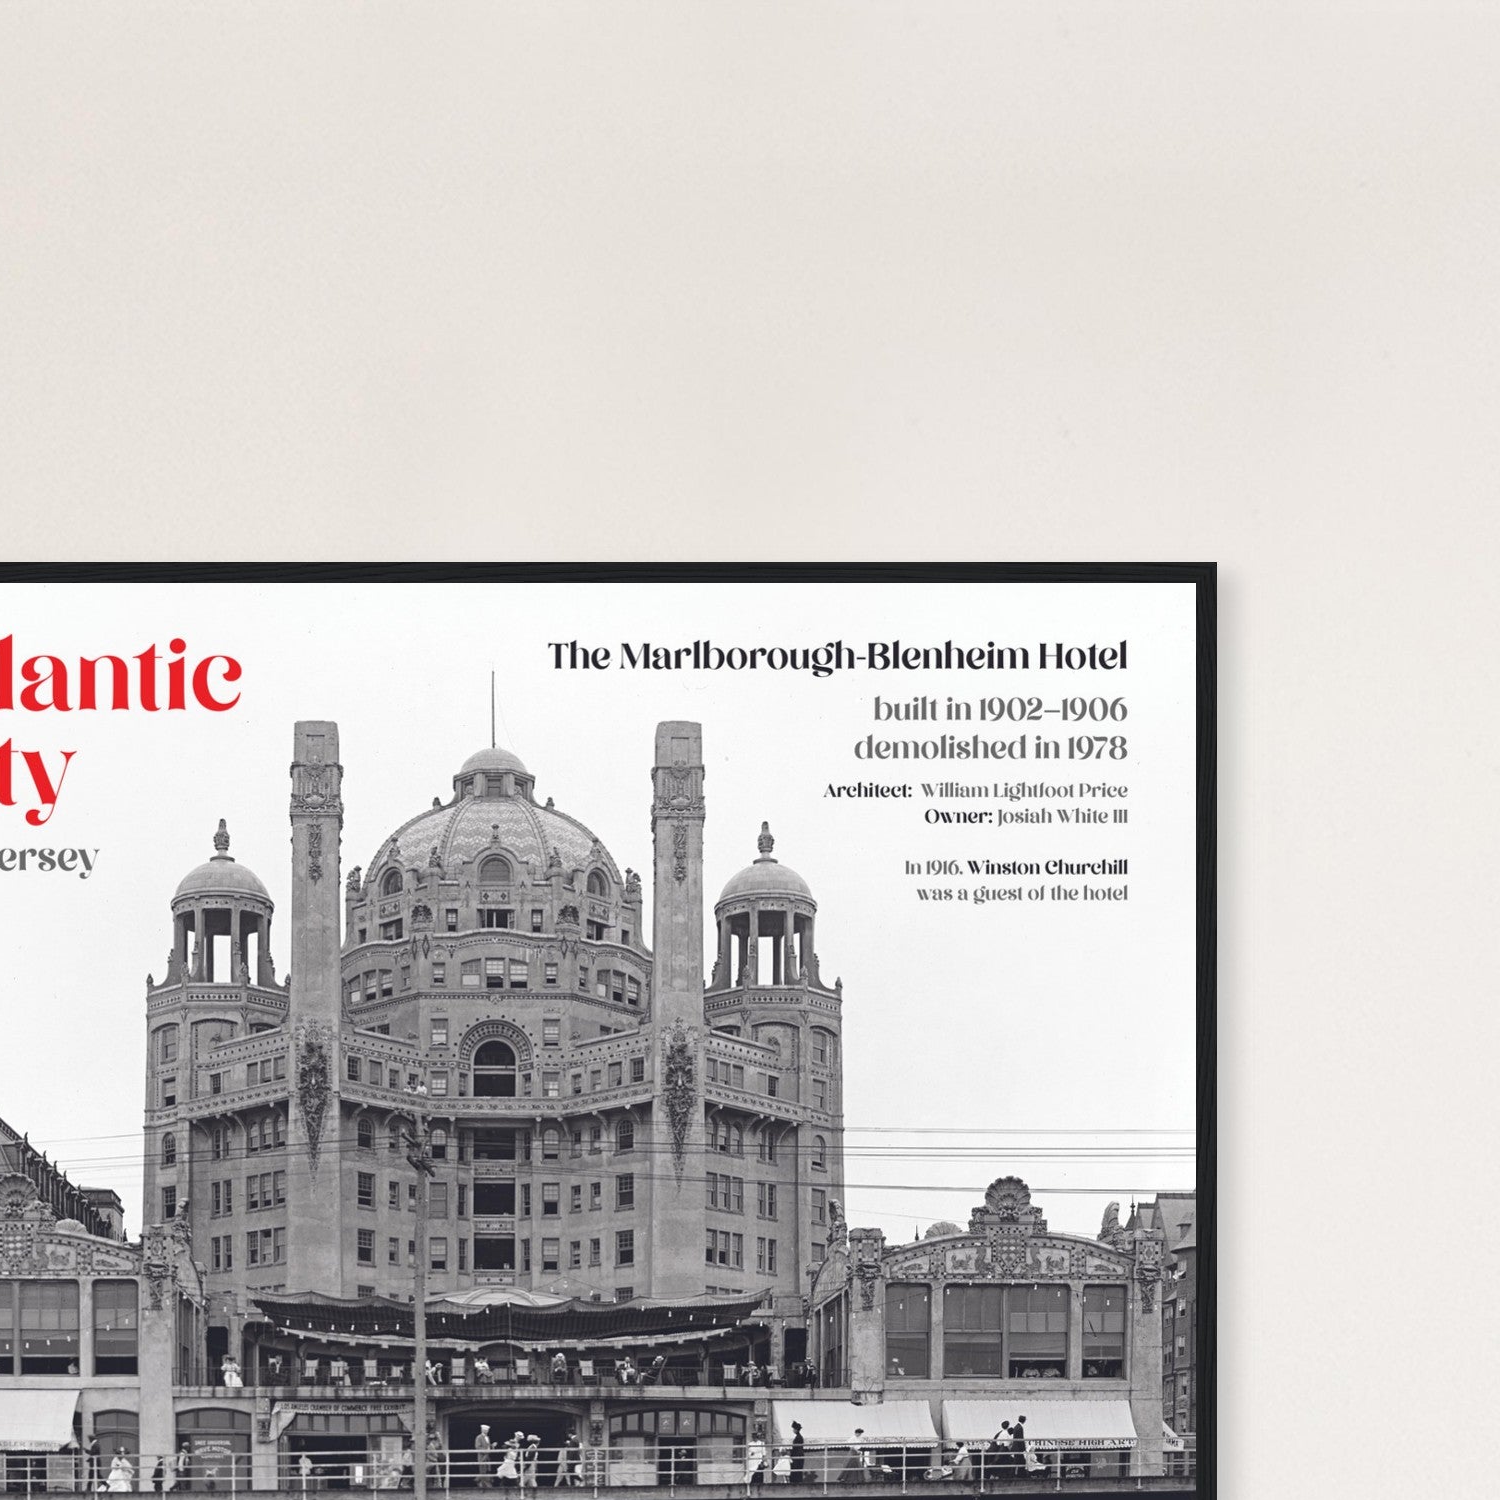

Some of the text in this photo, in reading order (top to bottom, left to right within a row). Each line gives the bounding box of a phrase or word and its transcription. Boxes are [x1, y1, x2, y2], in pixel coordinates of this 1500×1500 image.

[548, 640, 1127, 677] The Marlborough-Blenheim Hotel
[875, 696, 937, 721] built
[947, 697, 971, 720] in
[854, 734, 1127, 760] demolished in 1978
[824, 781, 1128, 802] Architect: William Lightfoot Price
[924, 808, 1128, 827] Owner: Josiah White III
[905, 861, 922, 875] In
[967, 859, 1041, 876] Winston
[1045, 859, 1128, 876] Churchill
[917, 885, 1128, 905] was a guest of the hotel
[341, 1403, 368, 1412] COMMERCE
[1078, 1439, 1105, 1447] HIGH
